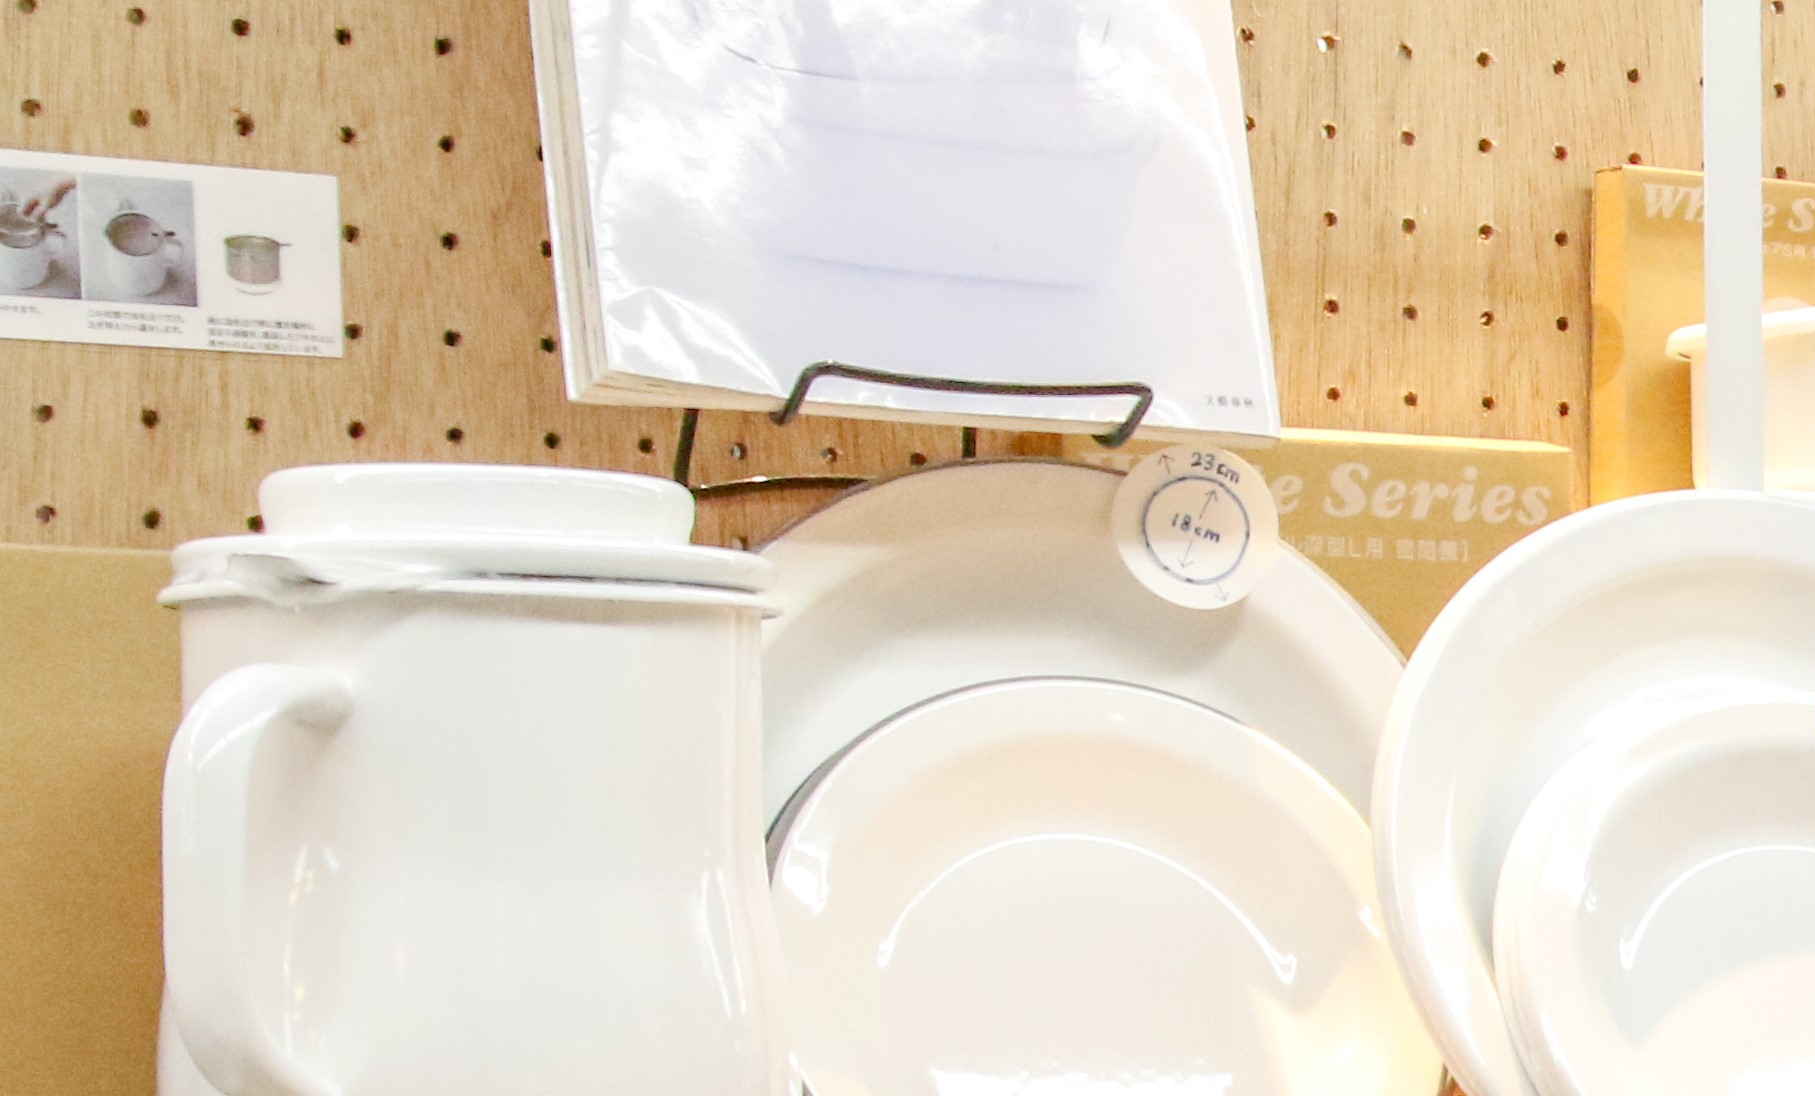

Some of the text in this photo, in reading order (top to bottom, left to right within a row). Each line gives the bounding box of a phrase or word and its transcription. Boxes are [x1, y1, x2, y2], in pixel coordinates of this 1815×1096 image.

[1204, 394, 1256, 411] 文藝春秋
[1190, 451, 1241, 485] 23cm
[1323, 460, 1552, 527] Series
[1171, 512, 1222, 546] 18cm
